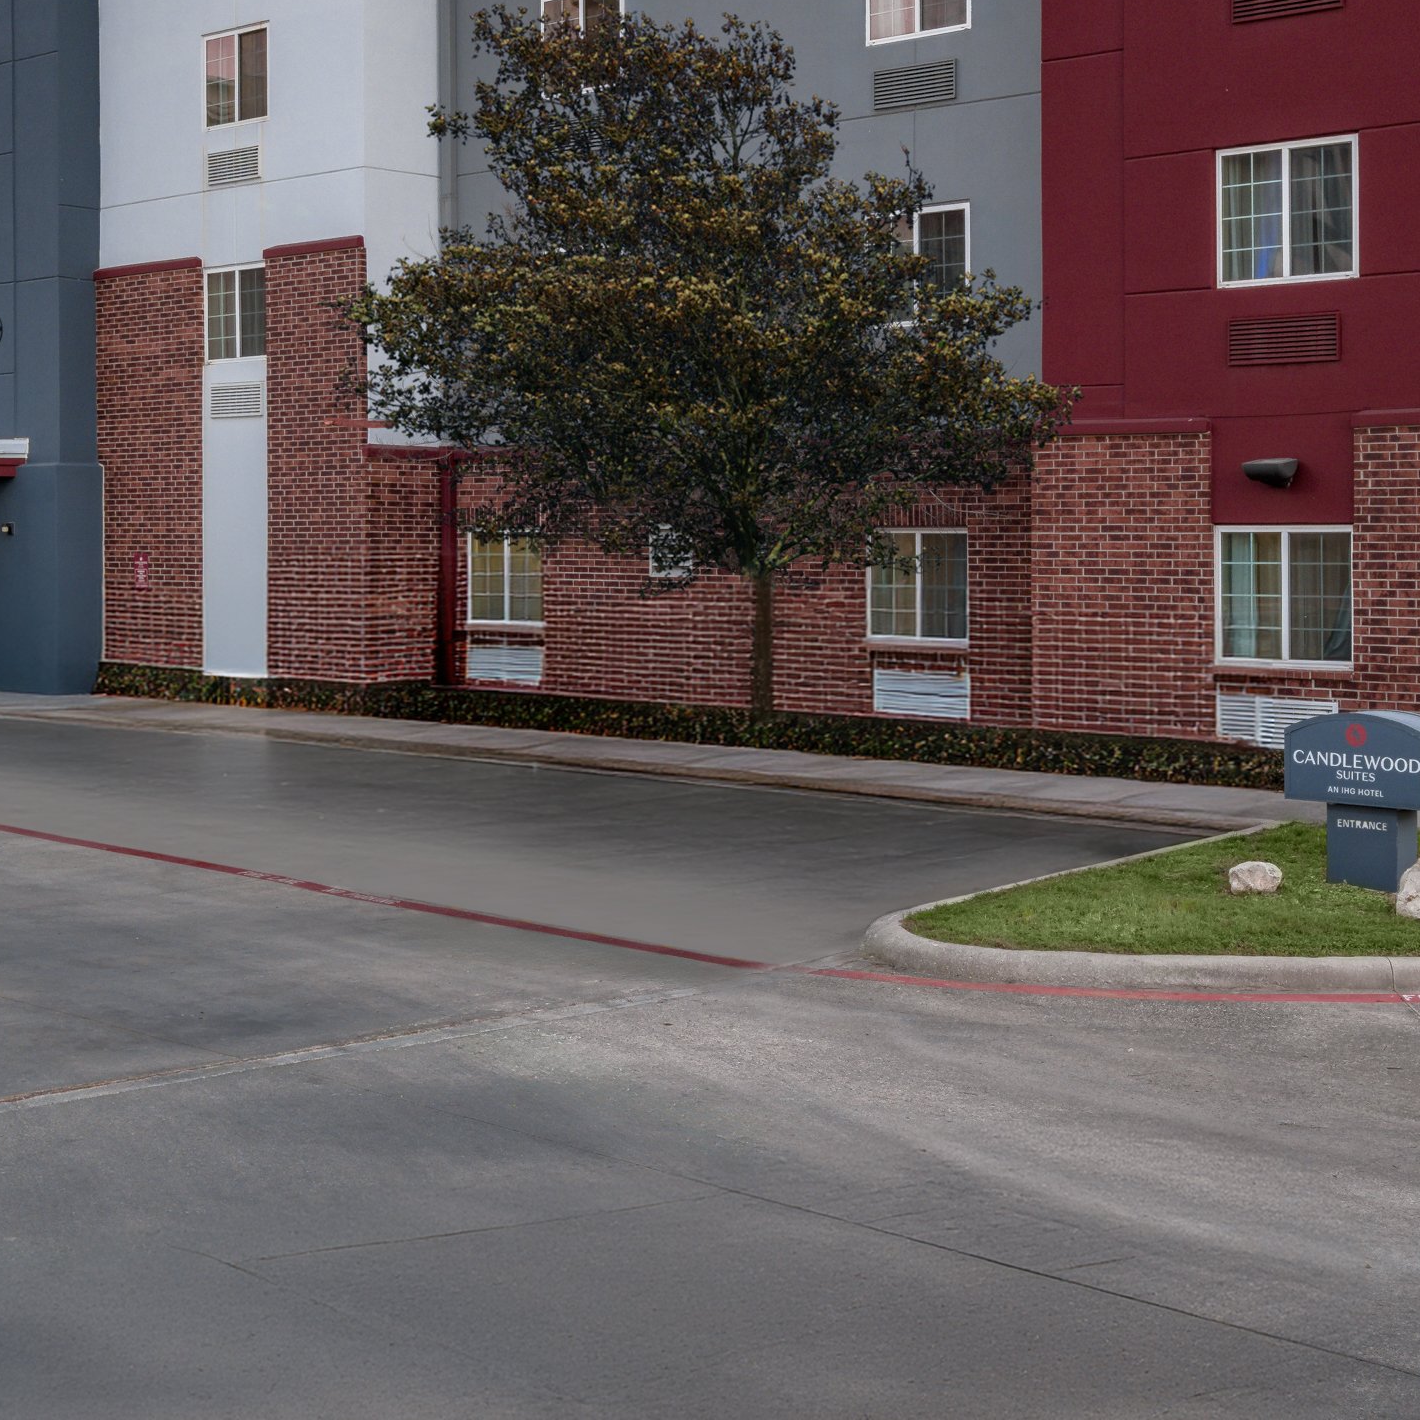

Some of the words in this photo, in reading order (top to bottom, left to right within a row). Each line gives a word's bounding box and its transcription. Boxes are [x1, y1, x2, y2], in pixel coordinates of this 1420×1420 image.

[1335, 769, 1376, 783] SUITES
[1327, 785, 1340, 794] AN
[1341, 786, 1356, 796] IHG
[1358, 787, 1384, 798] HOTEL
[1337, 818, 1388, 831] ENTRANCE
